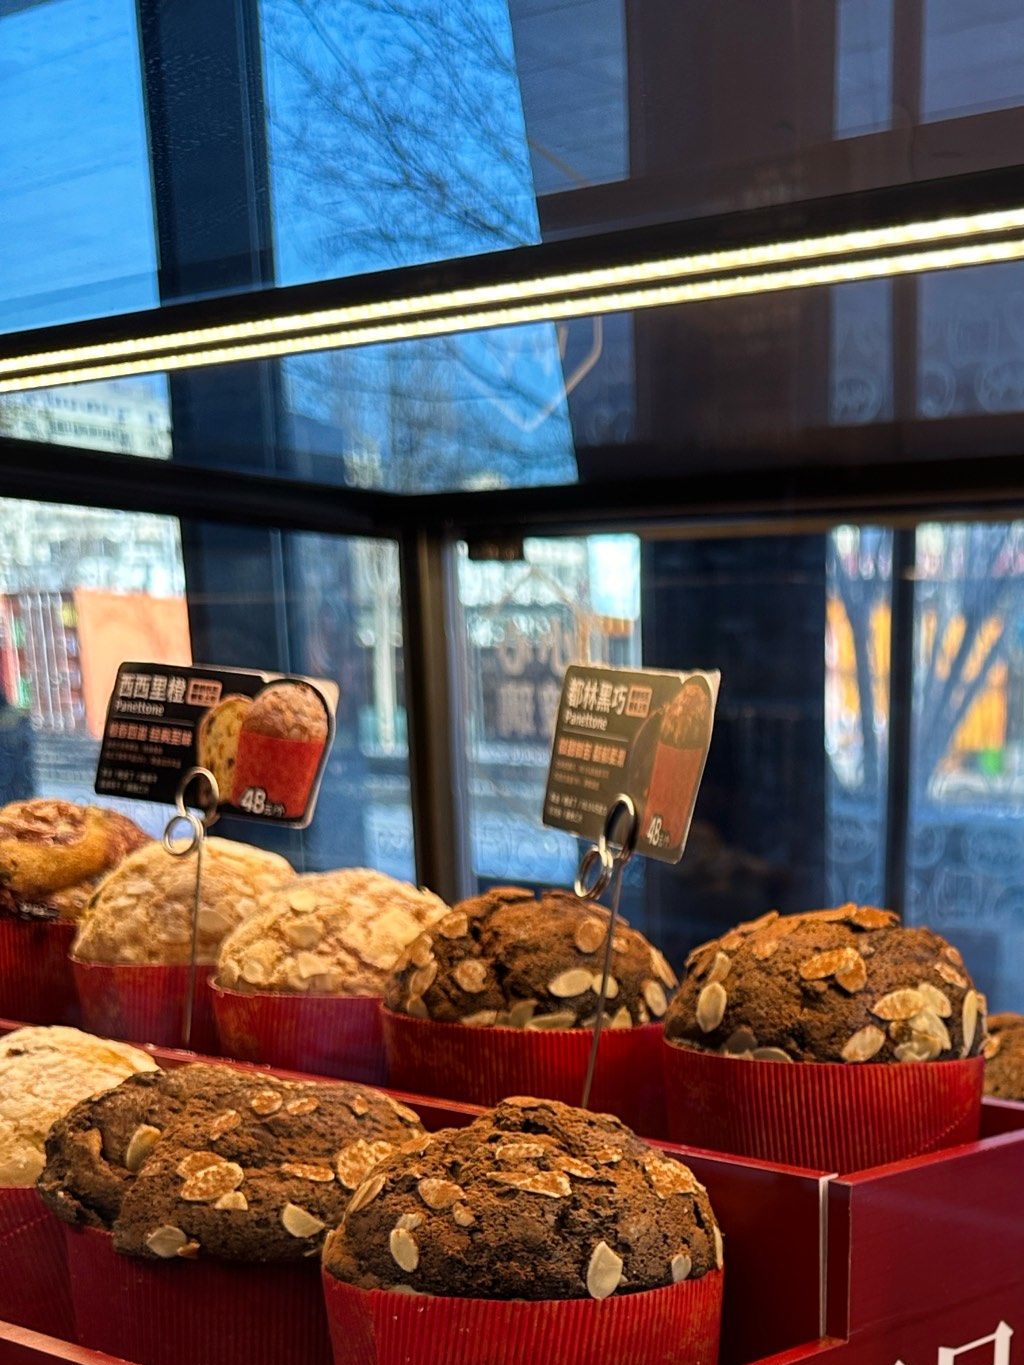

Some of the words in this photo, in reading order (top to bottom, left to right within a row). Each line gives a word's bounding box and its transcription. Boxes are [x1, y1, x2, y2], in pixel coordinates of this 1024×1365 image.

[118, 673, 187, 703] 西西里橙
[566, 677, 629, 716] 都林黑巧
[115, 701, 165, 717] Panettone
[564, 710, 608, 731] Panettone
